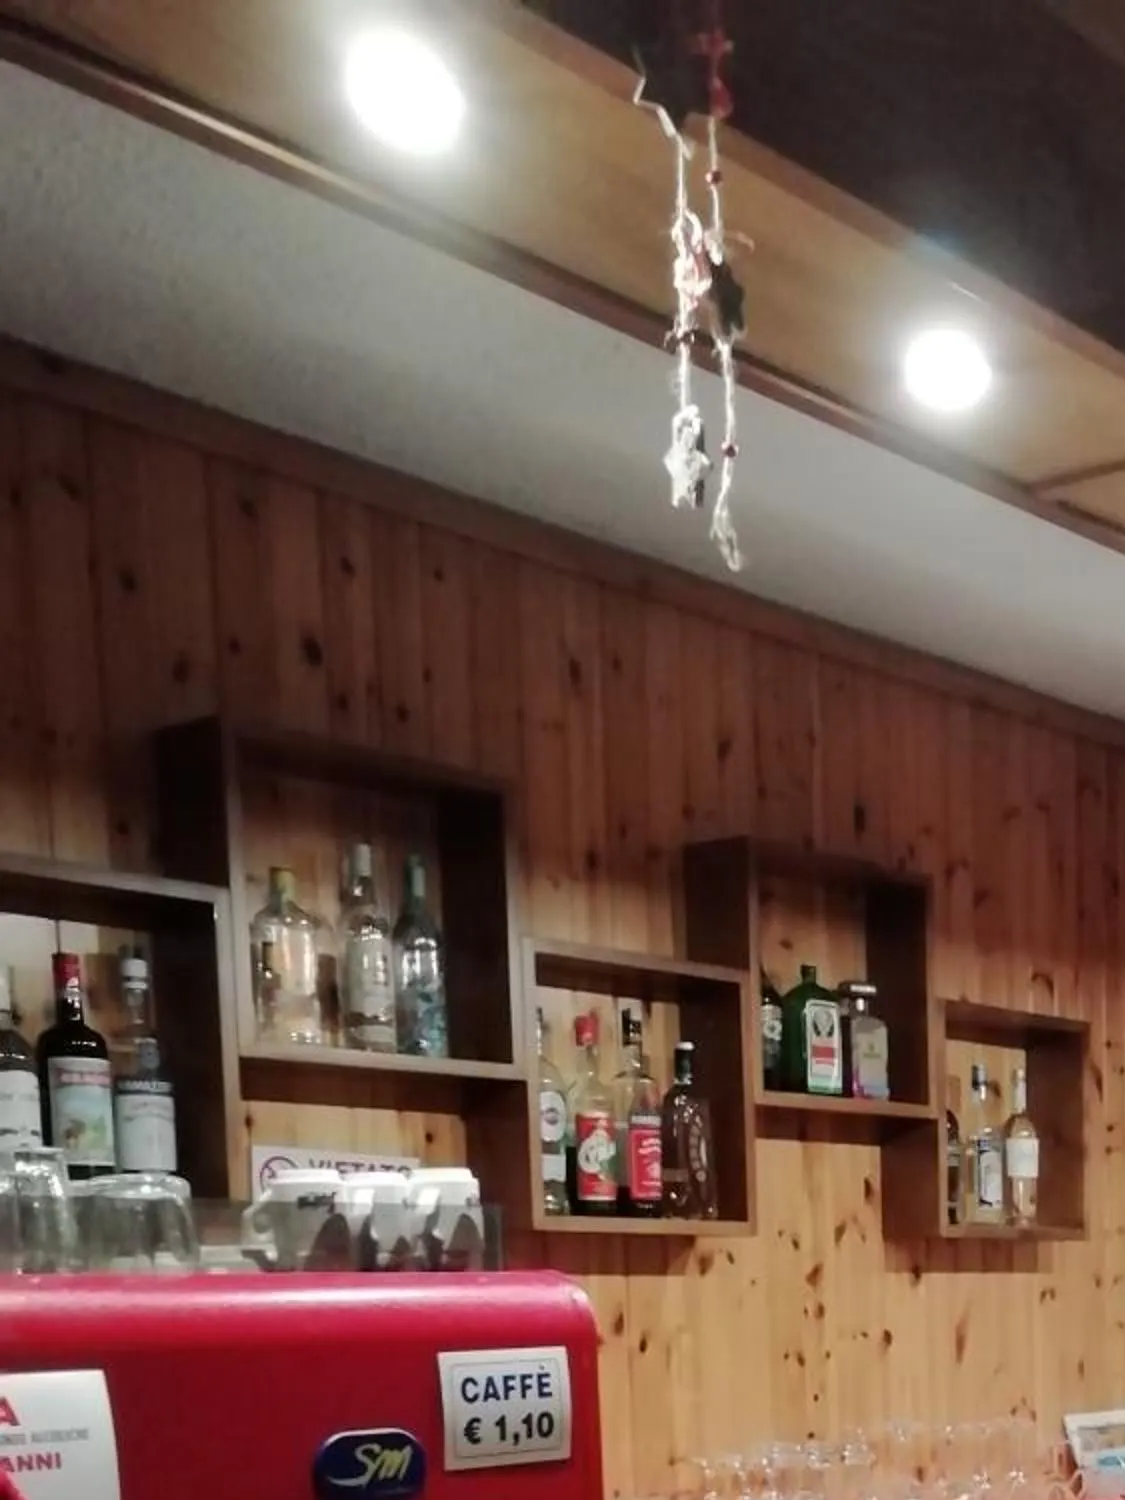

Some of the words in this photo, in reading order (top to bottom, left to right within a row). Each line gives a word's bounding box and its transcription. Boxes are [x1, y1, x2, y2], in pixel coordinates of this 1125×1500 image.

[461, 1365, 553, 1404] CAFFÈ
[464, 1417, 482, 1445] €
[495, 1411, 554, 1447] 1,10
